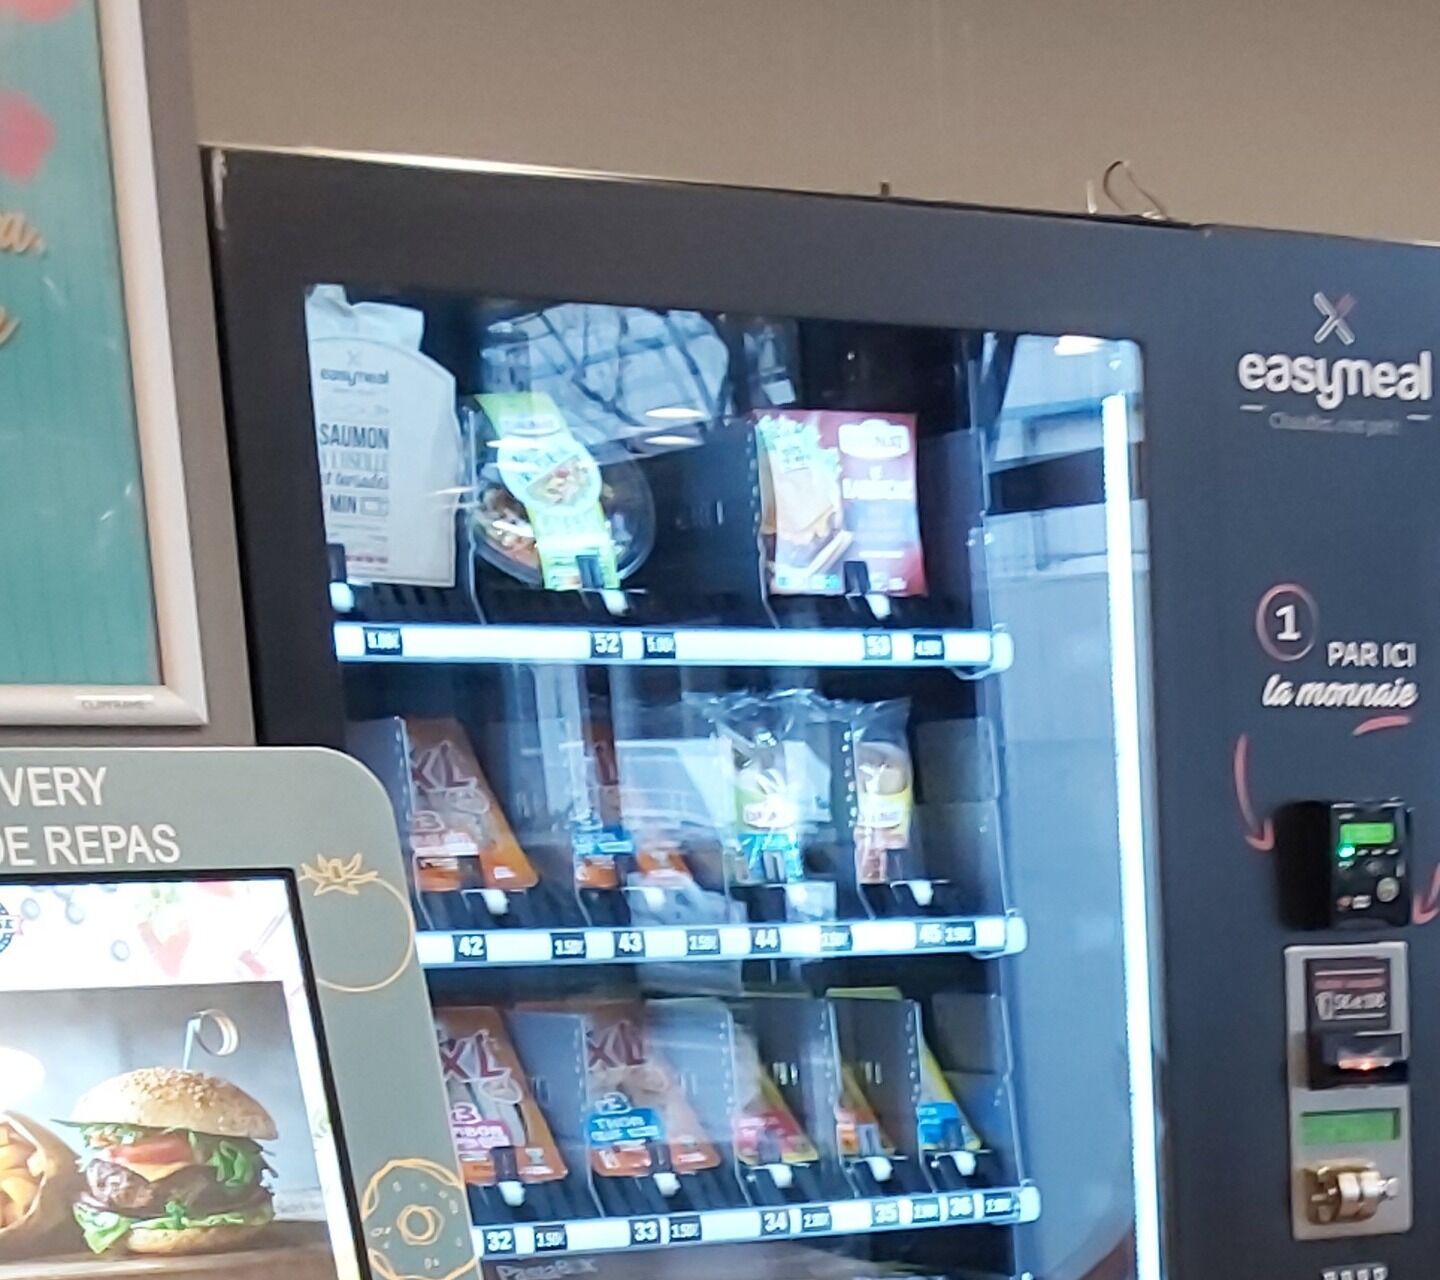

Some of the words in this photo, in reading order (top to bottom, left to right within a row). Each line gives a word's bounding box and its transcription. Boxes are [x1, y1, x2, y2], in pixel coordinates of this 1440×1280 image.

[1238, 351, 1433, 410] easymeal
[320, 424, 389, 450] SAUMON
[330, 494, 356, 515] MIN
[1276, 605, 1301, 641] 1
[595, 633, 620, 653] 52
[1328, 641, 1377, 668] PAR
[1382, 642, 1417, 668] ICI
[1262, 675, 1293, 708] la
[1295, 677, 1418, 709] monnaie
[0, 826, 37, 866] E
[43, 824, 181, 866] REPAS
[459, 936, 484, 955] 42
[619, 933, 643, 952] 43
[755, 929, 779, 948] 44
[634, 1221, 658, 1240] 33
[764, 1212, 788, 1231] 34
[487, 1231, 511, 1250] 32
